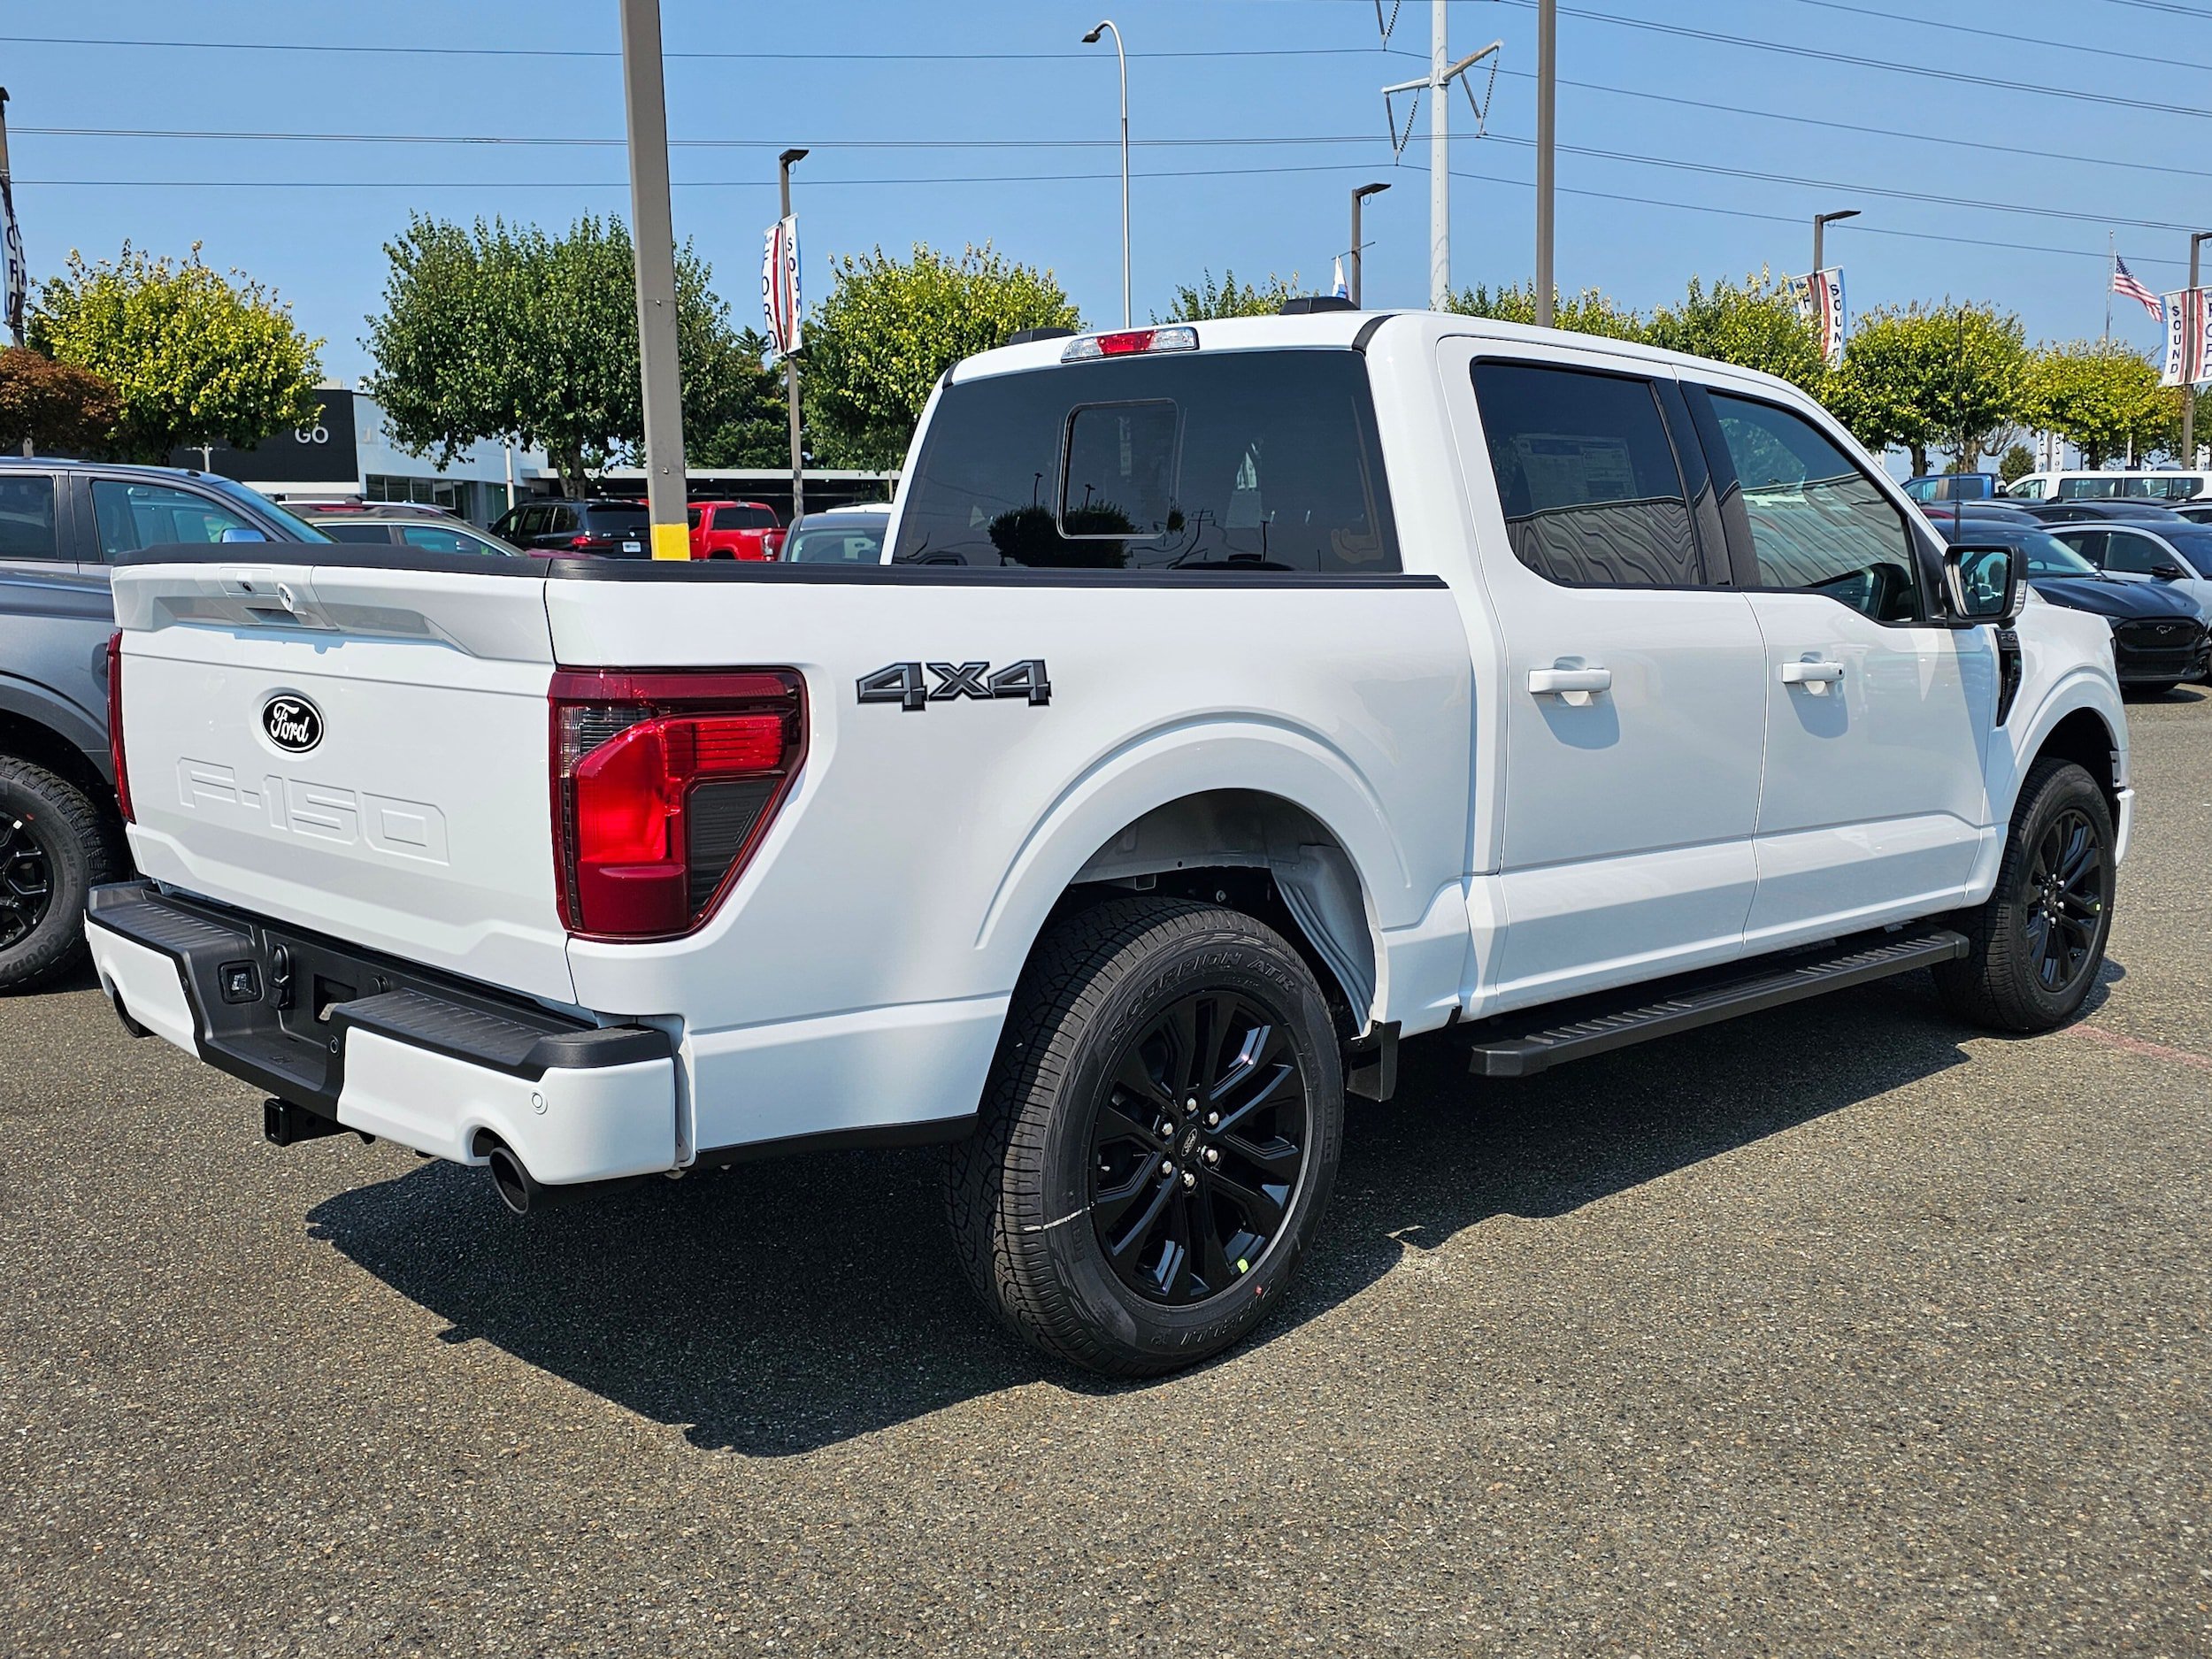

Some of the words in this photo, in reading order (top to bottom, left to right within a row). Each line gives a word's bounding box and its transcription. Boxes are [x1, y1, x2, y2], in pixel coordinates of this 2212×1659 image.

[2170, 305, 2181, 374] SOUND
[856, 658, 1052, 712] 4X4
[270, 702, 310, 743] Ford
[177, 757, 450, 866] F-150
[1110, 951, 1242, 1042] SCORPION
[1247, 956, 1295, 995] ATR
